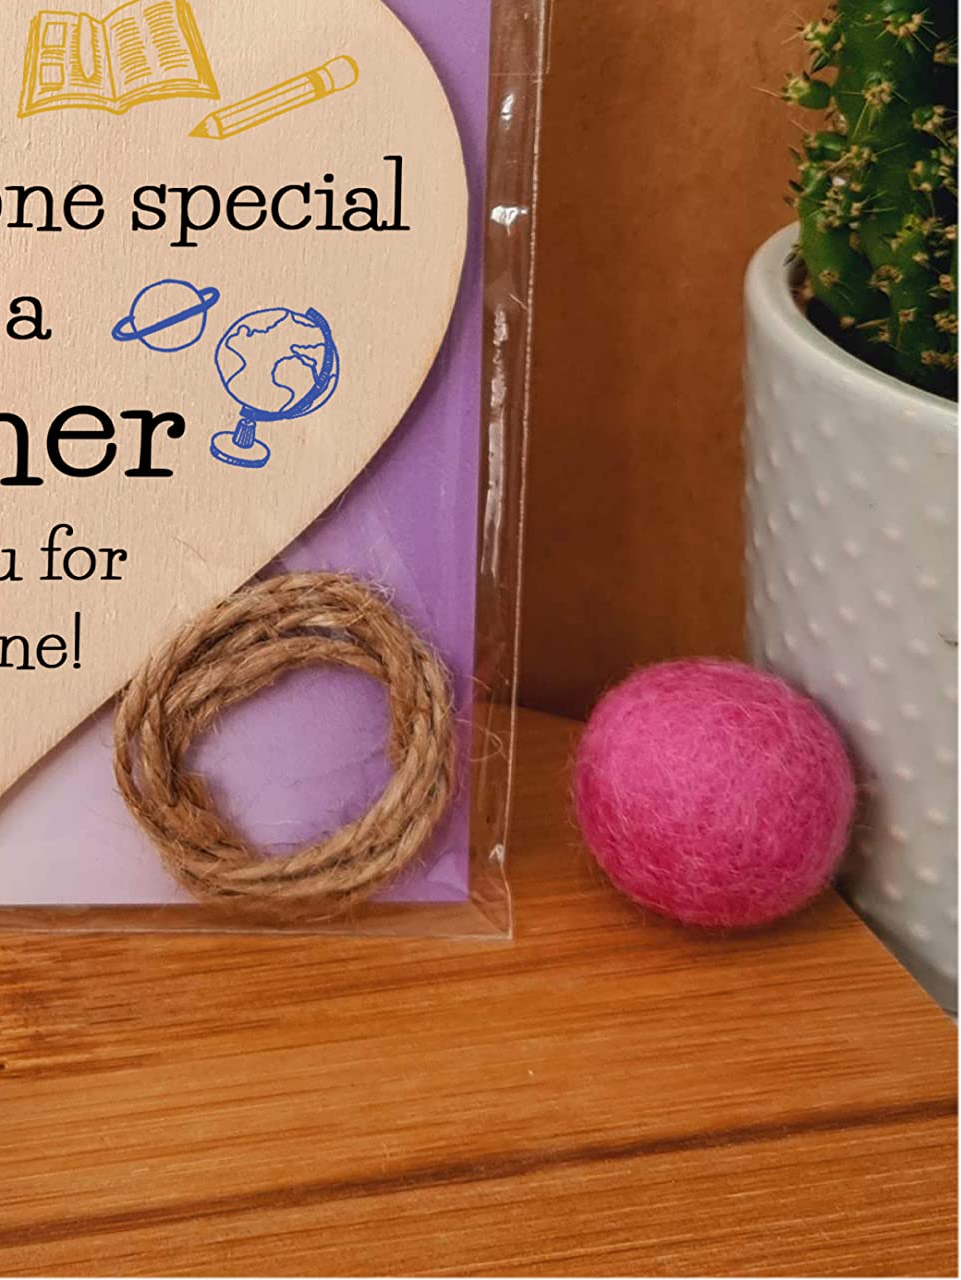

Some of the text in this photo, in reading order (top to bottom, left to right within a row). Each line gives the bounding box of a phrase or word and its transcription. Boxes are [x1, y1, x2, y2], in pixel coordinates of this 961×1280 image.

[131, 156, 411, 247] special
[6, 296, 52, 339] a
[39, 523, 128, 582] for
